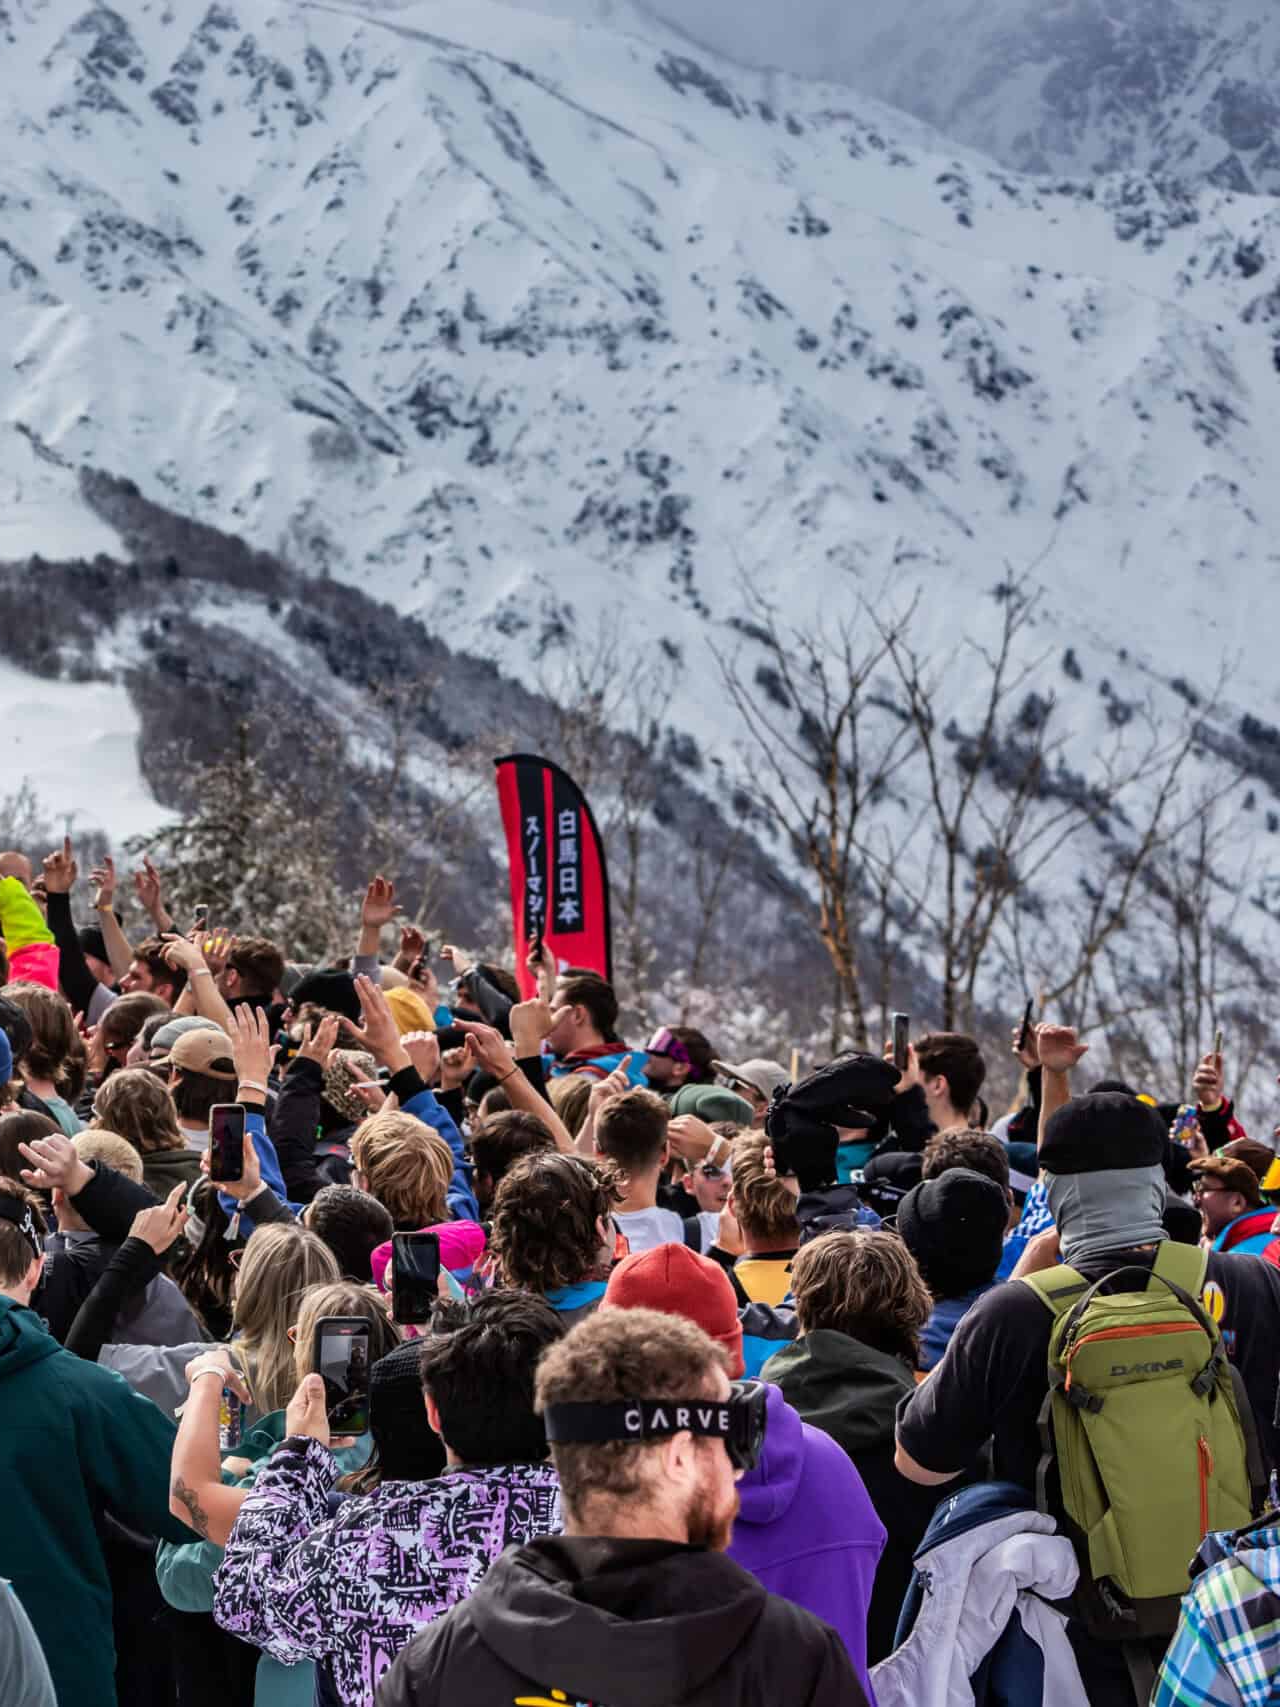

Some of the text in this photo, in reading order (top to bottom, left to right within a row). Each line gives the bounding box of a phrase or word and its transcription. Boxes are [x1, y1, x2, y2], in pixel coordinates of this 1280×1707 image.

[525, 815, 544, 928] スノーマシ
[557, 808, 580, 925] 白馬日本
[624, 1407, 730, 1431] CARVE
